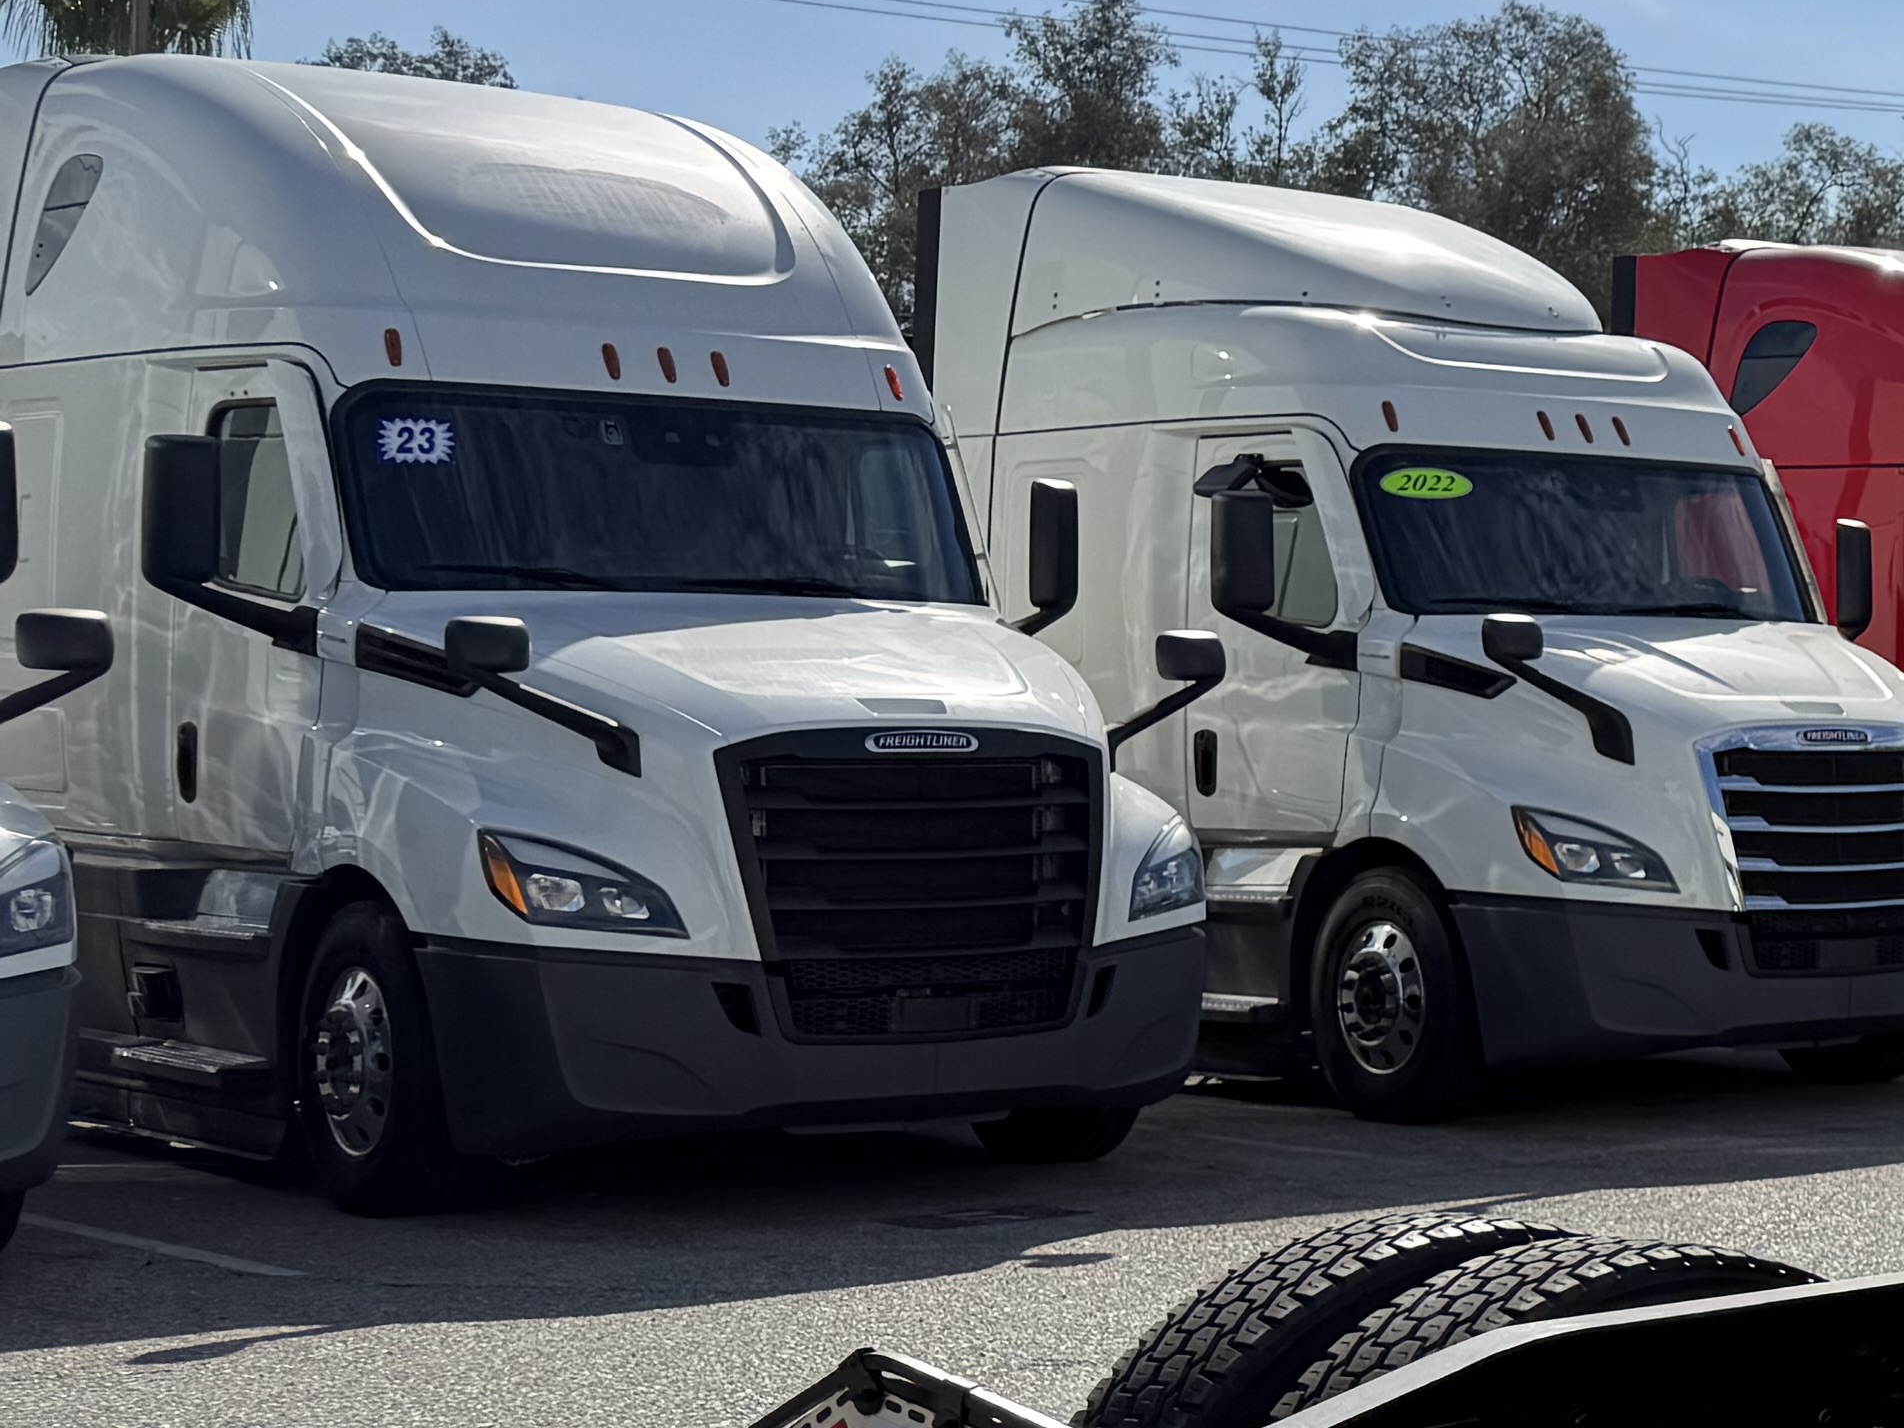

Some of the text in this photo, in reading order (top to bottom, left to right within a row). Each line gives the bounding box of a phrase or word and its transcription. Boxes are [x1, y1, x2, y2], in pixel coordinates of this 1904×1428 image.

[395, 426, 436, 456] 23
[1396, 473, 1456, 492] 2022
[878, 733, 968, 749] FREIGHTLINER
